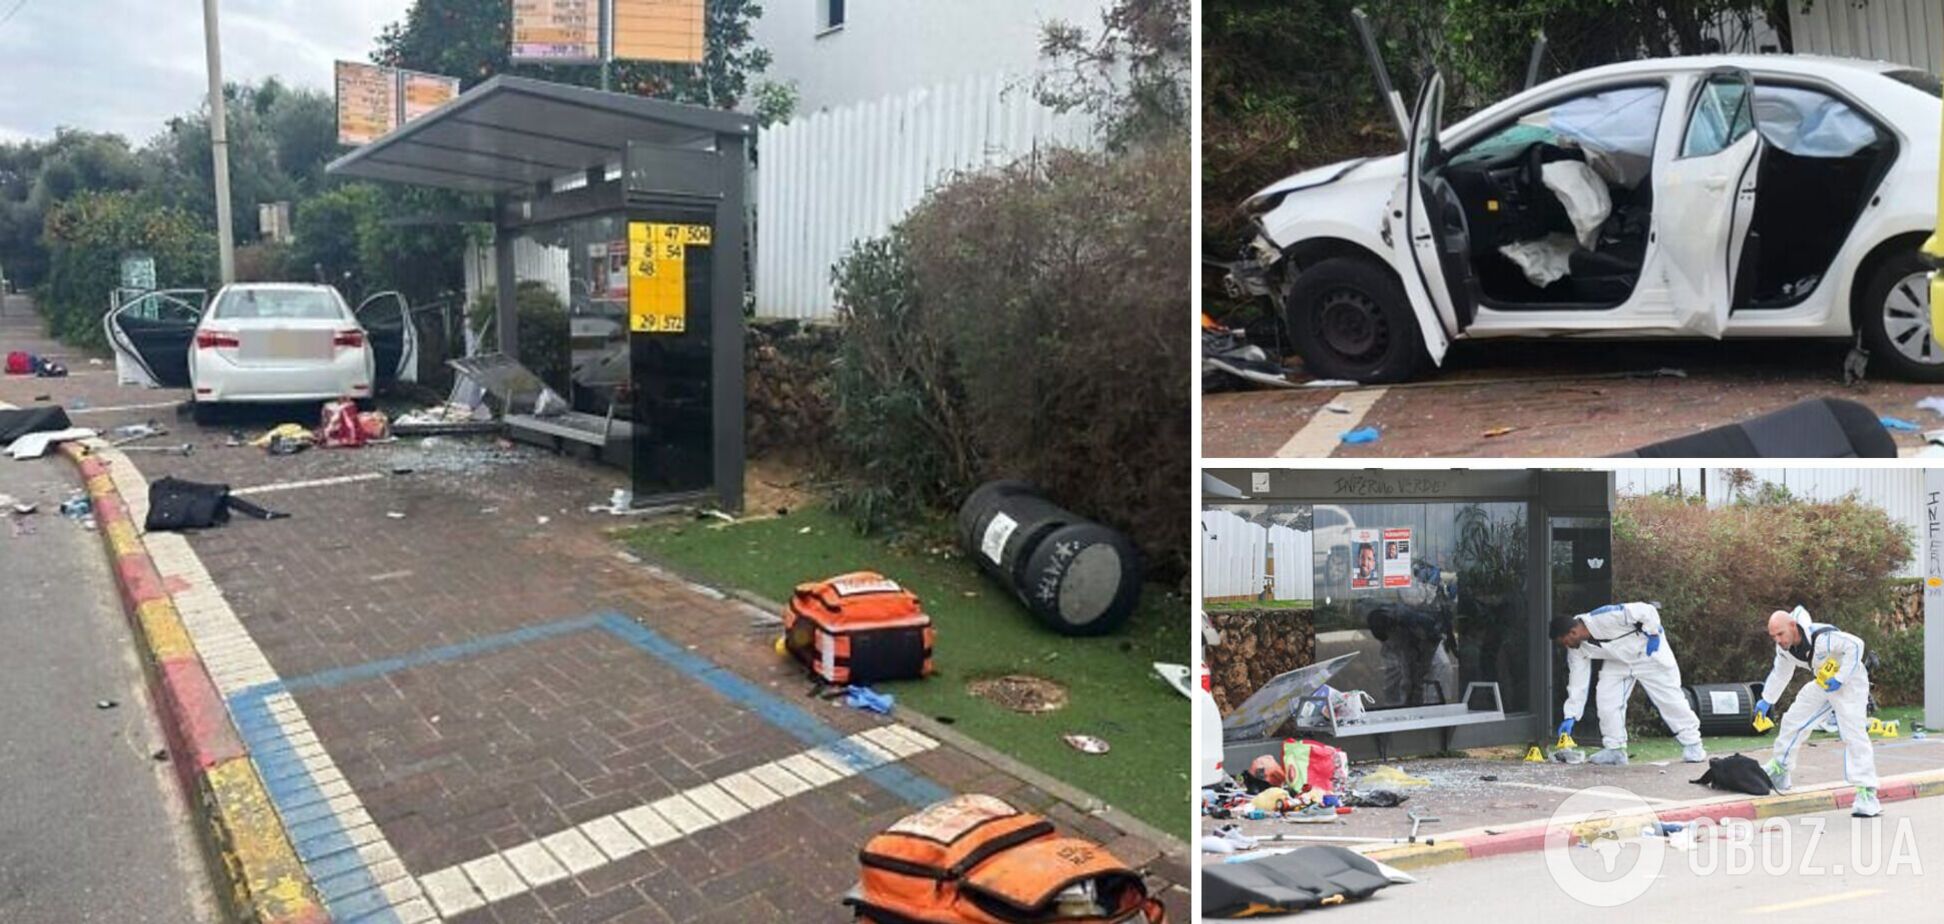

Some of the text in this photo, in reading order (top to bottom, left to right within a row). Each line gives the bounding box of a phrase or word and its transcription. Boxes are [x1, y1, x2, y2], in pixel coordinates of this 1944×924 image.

[645, 225, 709, 241] 1 47 504
[644, 243, 681, 258] 8 54
[638, 261, 654, 276] 48
[641, 314, 656, 328] 29
